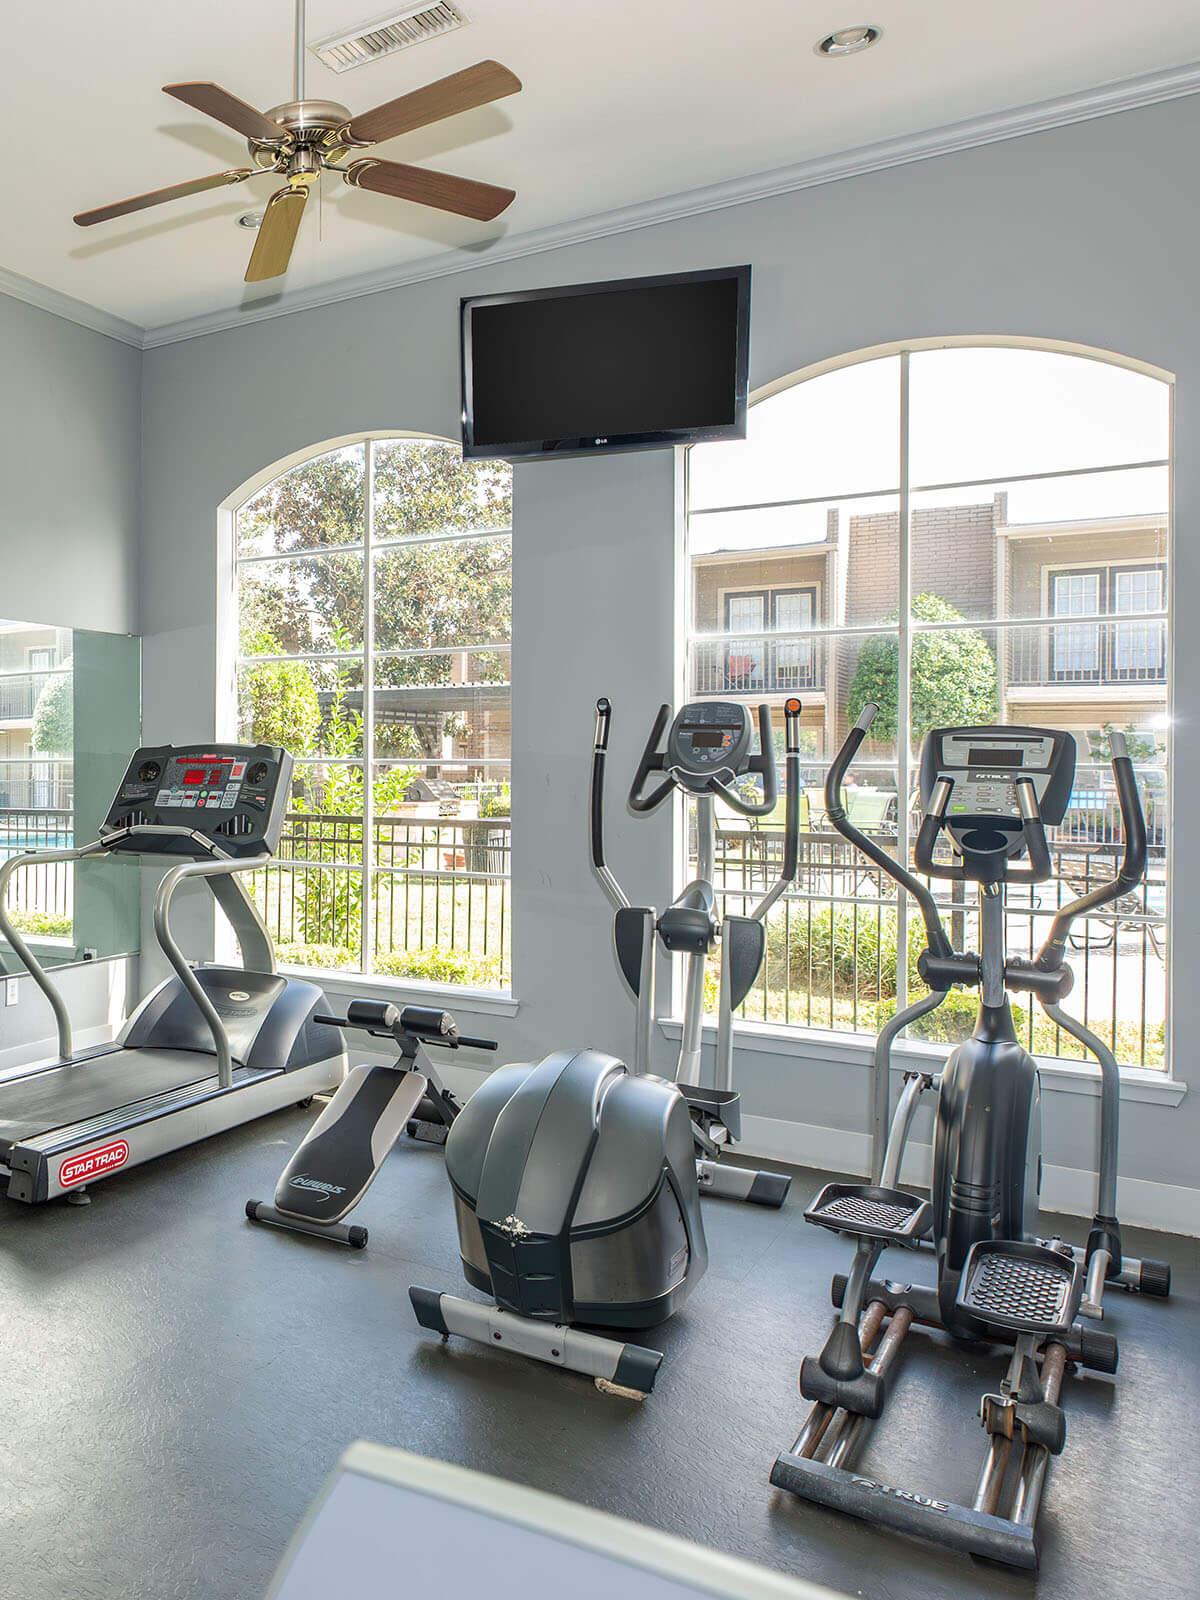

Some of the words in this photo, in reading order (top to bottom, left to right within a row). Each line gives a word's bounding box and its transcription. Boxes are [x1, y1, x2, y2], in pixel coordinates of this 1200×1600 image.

[63, 1159, 94, 1180] STAR
[94, 1148, 123, 1168] TRAC
[879, 1484, 950, 1512] TRUE
